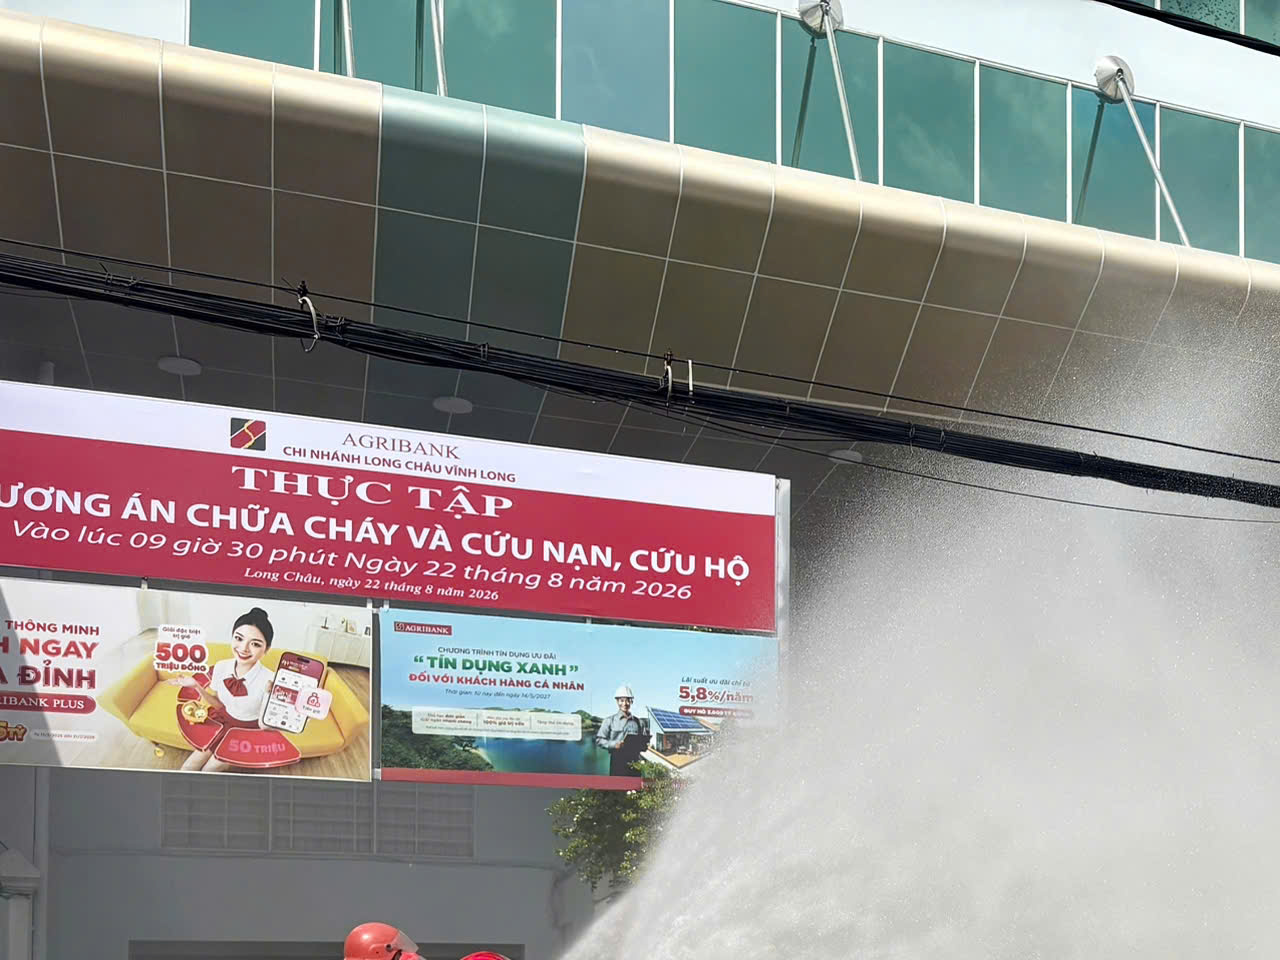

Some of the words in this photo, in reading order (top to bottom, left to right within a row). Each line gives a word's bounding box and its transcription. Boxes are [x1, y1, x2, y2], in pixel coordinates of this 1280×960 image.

[342, 433, 460, 459] AGRIBANK
[283, 446, 307, 457] CHI
[310, 449, 361, 465] NHÁNH
[364, 455, 402, 469] LONG
[405, 459, 442, 474] CHÂU
[445, 464, 477, 479] VĨNH
[480, 470, 516, 483] LONG
[231, 465, 392, 506] THỰC
[408, 485, 513, 520] TẬP
[0, 481, 111, 517] ƯƠNG
[121, 488, 175, 524] ÁN
[186, 504, 296, 537] CHỮA
[304, 515, 399, 546] CHÁY
[406, 524, 452, 551] VÀ
[461, 531, 533, 560] CỨU
[543, 540, 622, 571] NẠN,
[629, 548, 696, 575] CỨU
[705, 555, 750, 586] HỘ
[12, 519, 69, 541] Vào
[78, 524, 122, 547] lúc
[130, 532, 166, 549] 09
[172, 537, 222, 556] giờ
[227, 541, 263, 558] 30
[269, 542, 338, 566] phút
[344, 551, 418, 577] Ngày
[423, 560, 456, 578] 22
[463, 564, 541, 589] tháng
[548, 573, 563, 588] 8
[570, 574, 626, 594] năm
[632, 580, 692, 600] 2026
[244, 567, 279, 583] Long
[284, 570, 325, 586] Châu,
[330, 576, 361, 590] ngày
[365, 578, 379, 590] 22
[384, 580, 421, 595] tháng
[425, 584, 433, 594] 8
[437, 585, 464, 598] năm
[469, 588, 499, 600] 2026
[5, 619, 57, 633] THÔNG
[62, 624, 99, 636] MINH
[405, 624, 449, 634] AGRIBANK
[20, 638, 99, 659] NGAY
[156, 642, 206, 664] 500
[438, 646, 470, 655] CHƯƠNG
[472, 647, 494, 656] TRÌNH
[461, 658, 512, 675] DỤNG
[409, 671, 430, 682] ĐỐI
[433, 673, 454, 683] VỚI
[456, 675, 497, 686] KHÁCH
[499, 677, 531, 688] HÀNG
[534, 679, 549, 689] CÁ
[552, 680, 585, 691] NHÂN
[53, 699, 84, 709] PLUS
[228, 739, 251, 753] 50
